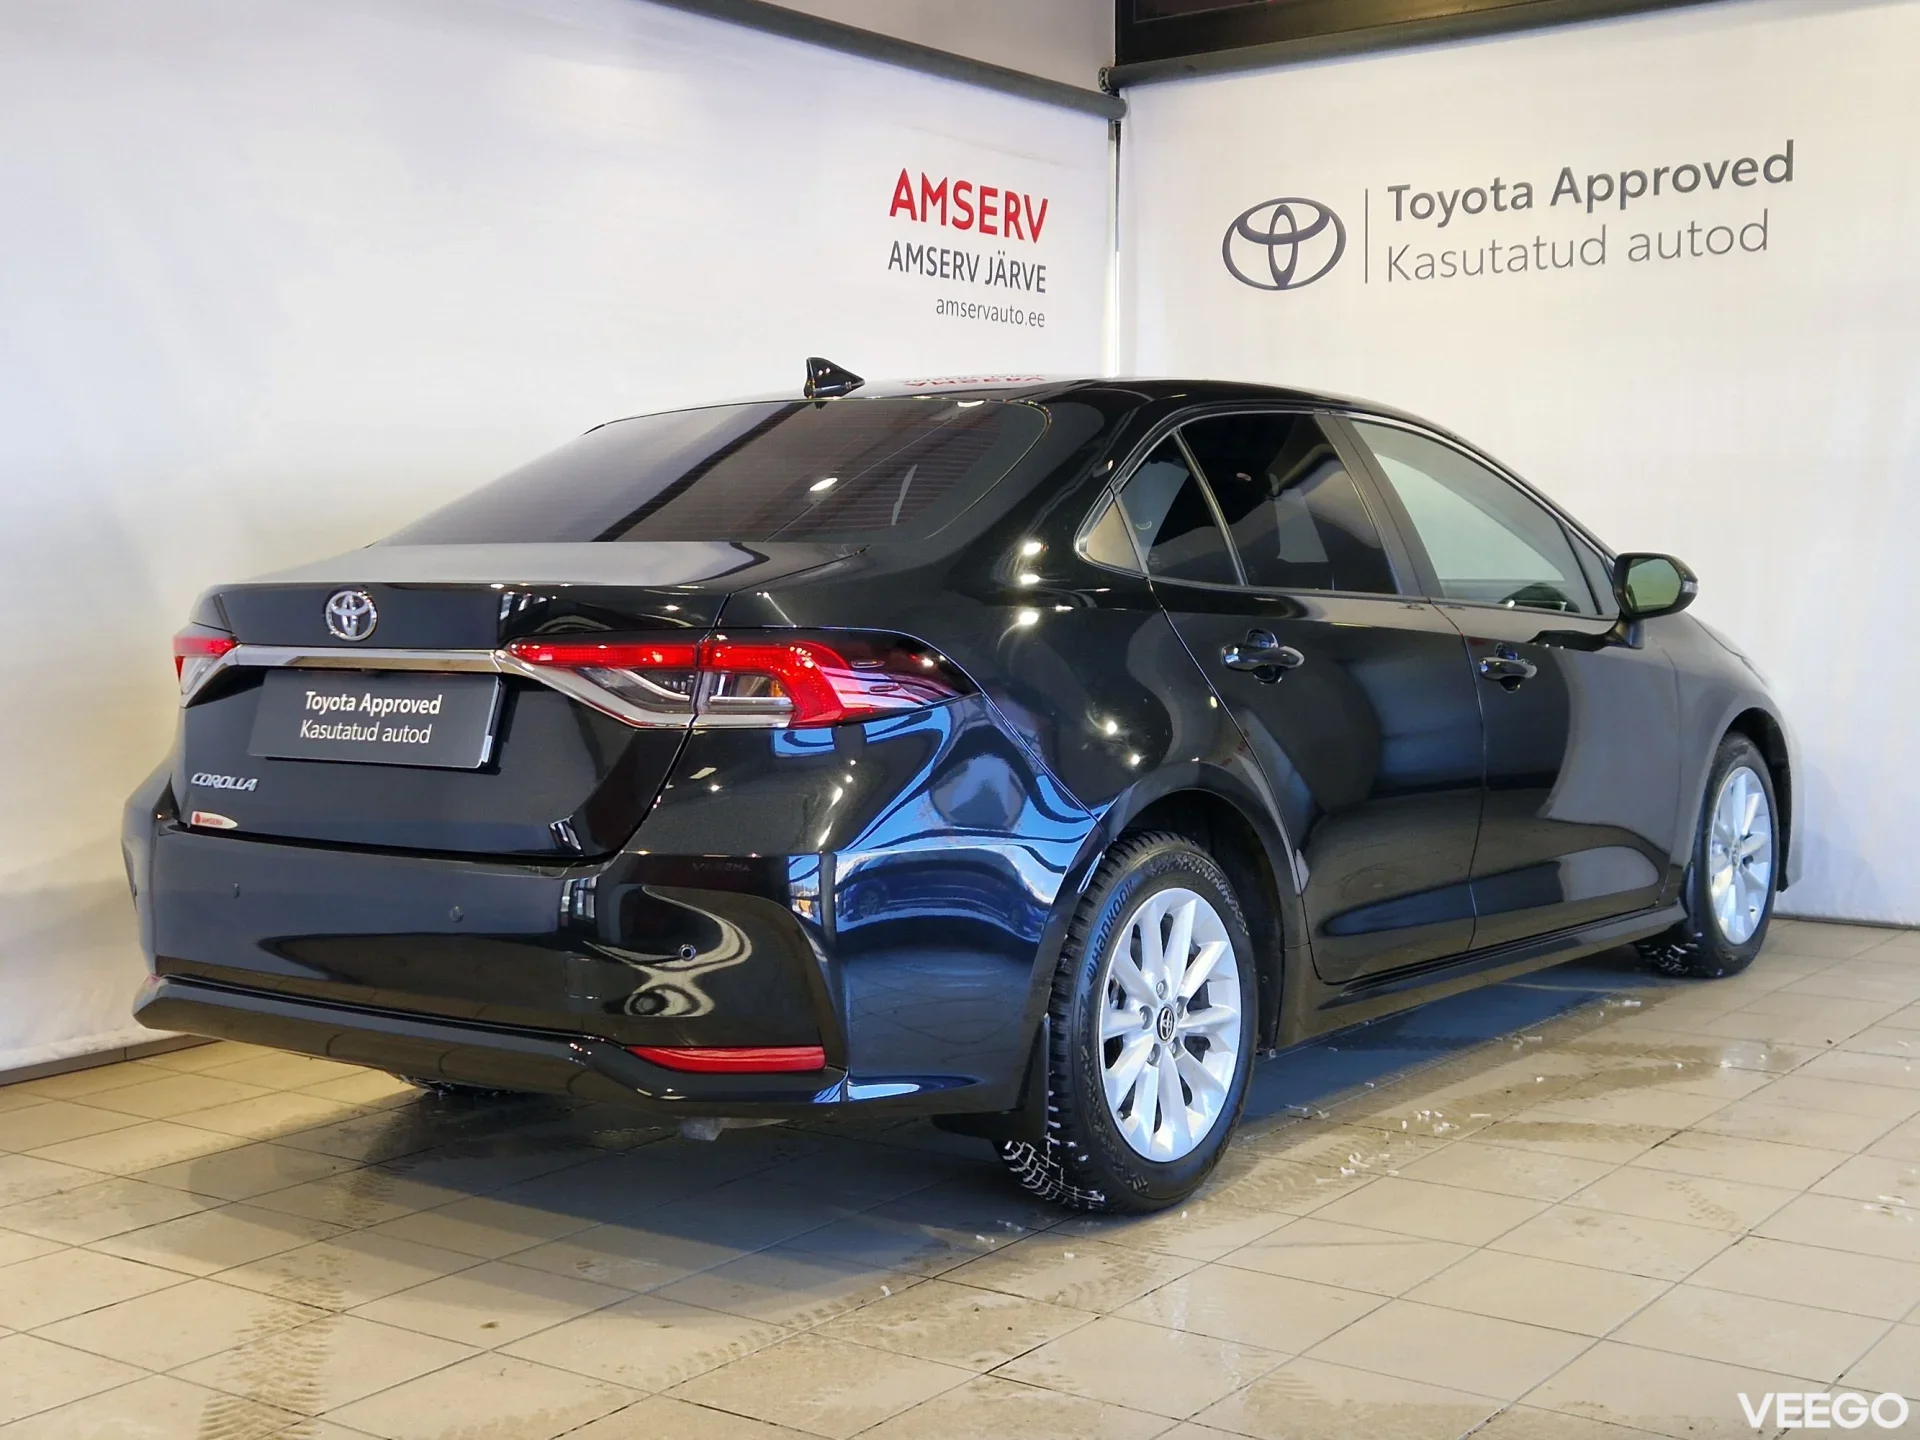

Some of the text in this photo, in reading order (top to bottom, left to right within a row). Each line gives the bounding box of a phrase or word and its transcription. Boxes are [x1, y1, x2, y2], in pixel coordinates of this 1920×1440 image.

[1387, 138, 1795, 229] Toyota Approved
[889, 167, 1049, 244] AMSERV
[1388, 208, 1768, 282] Kasutatud autod
[888, 240, 1047, 294] AMSERV JÄRVE
[936, 298, 1046, 328] amservauto.ee
[305, 691, 443, 718] Toyota Approved
[300, 719, 433, 744] Kasutatud autod
[190, 772, 258, 791] COROLLA
